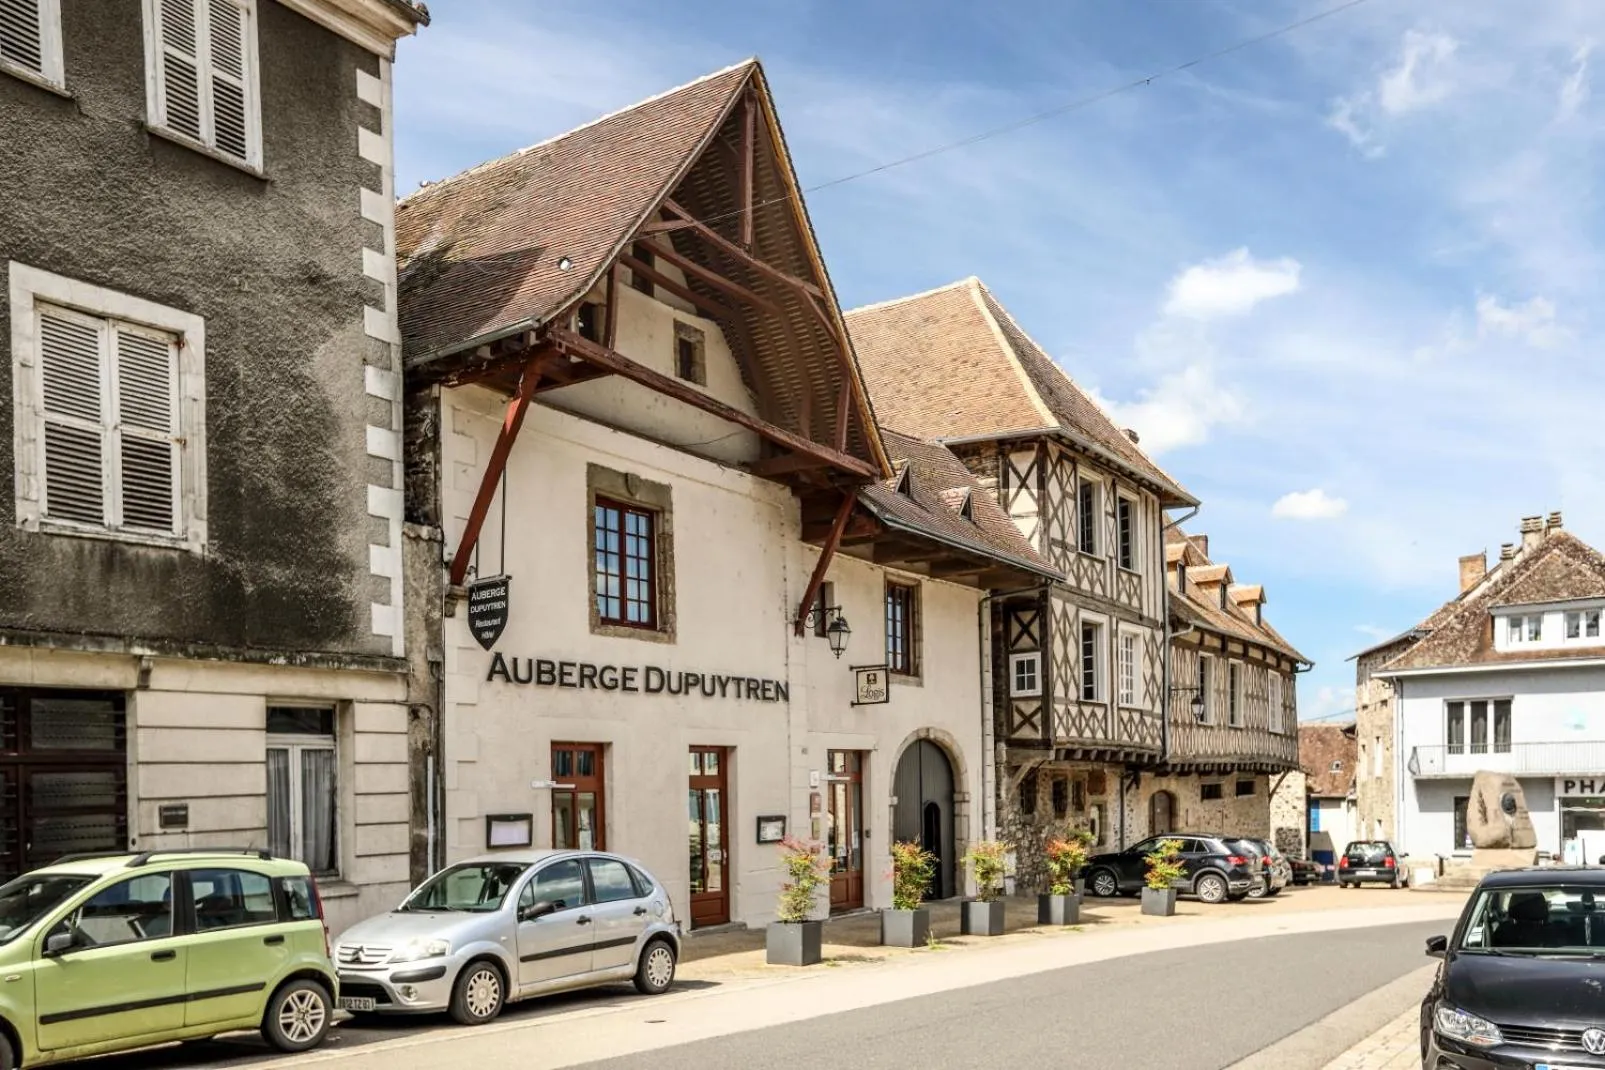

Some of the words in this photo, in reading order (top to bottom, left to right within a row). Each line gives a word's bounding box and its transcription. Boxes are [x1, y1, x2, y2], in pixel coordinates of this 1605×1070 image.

[471, 586, 506, 601] AUBERGE
[470, 600, 506, 613] DUPUYTREN
[486, 652, 639, 692] AUBERGE
[645, 666, 790, 701] DUPUYTREN
